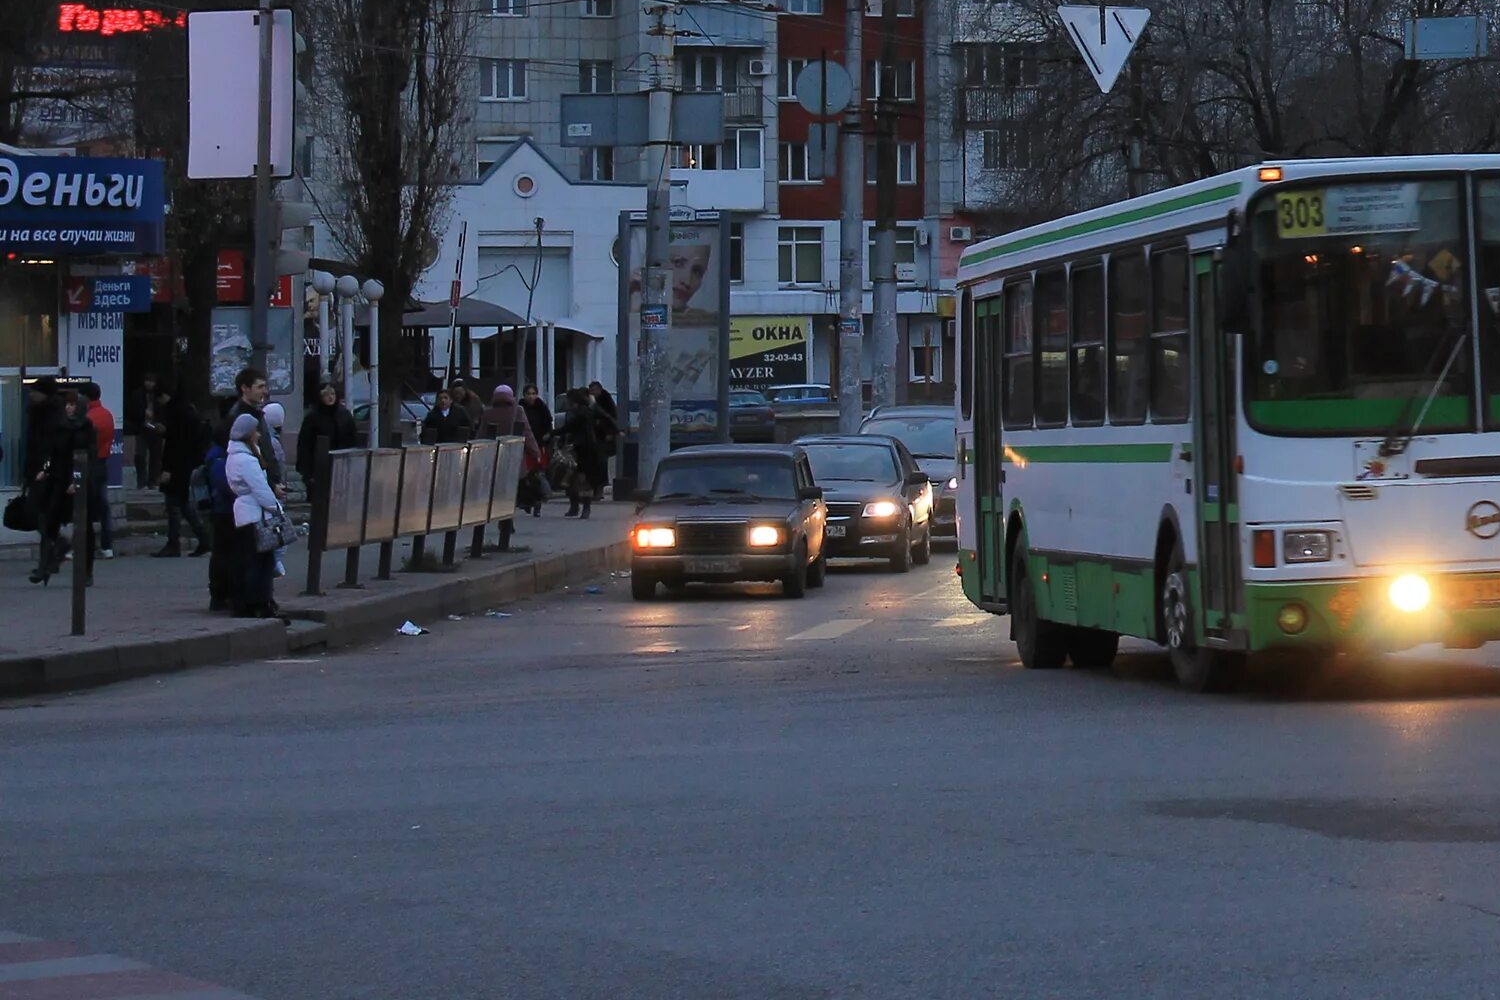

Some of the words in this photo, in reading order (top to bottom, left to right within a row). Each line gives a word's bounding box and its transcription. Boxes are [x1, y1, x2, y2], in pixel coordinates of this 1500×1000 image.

[1281, 197, 1323, 229] 303
[10, 229, 30, 241] на
[33, 229, 57, 241] все
[60, 229, 103, 246] случаи
[104, 230, 136, 242] жизни
[94, 280, 131, 294] Деньги
[94, 295, 131, 308] здесь
[752, 326, 803, 341] ОКНА
[88, 345, 121, 367] денег
[763, 353, 803, 362] 32-03-43
[729, 366, 775, 379] AYZER
